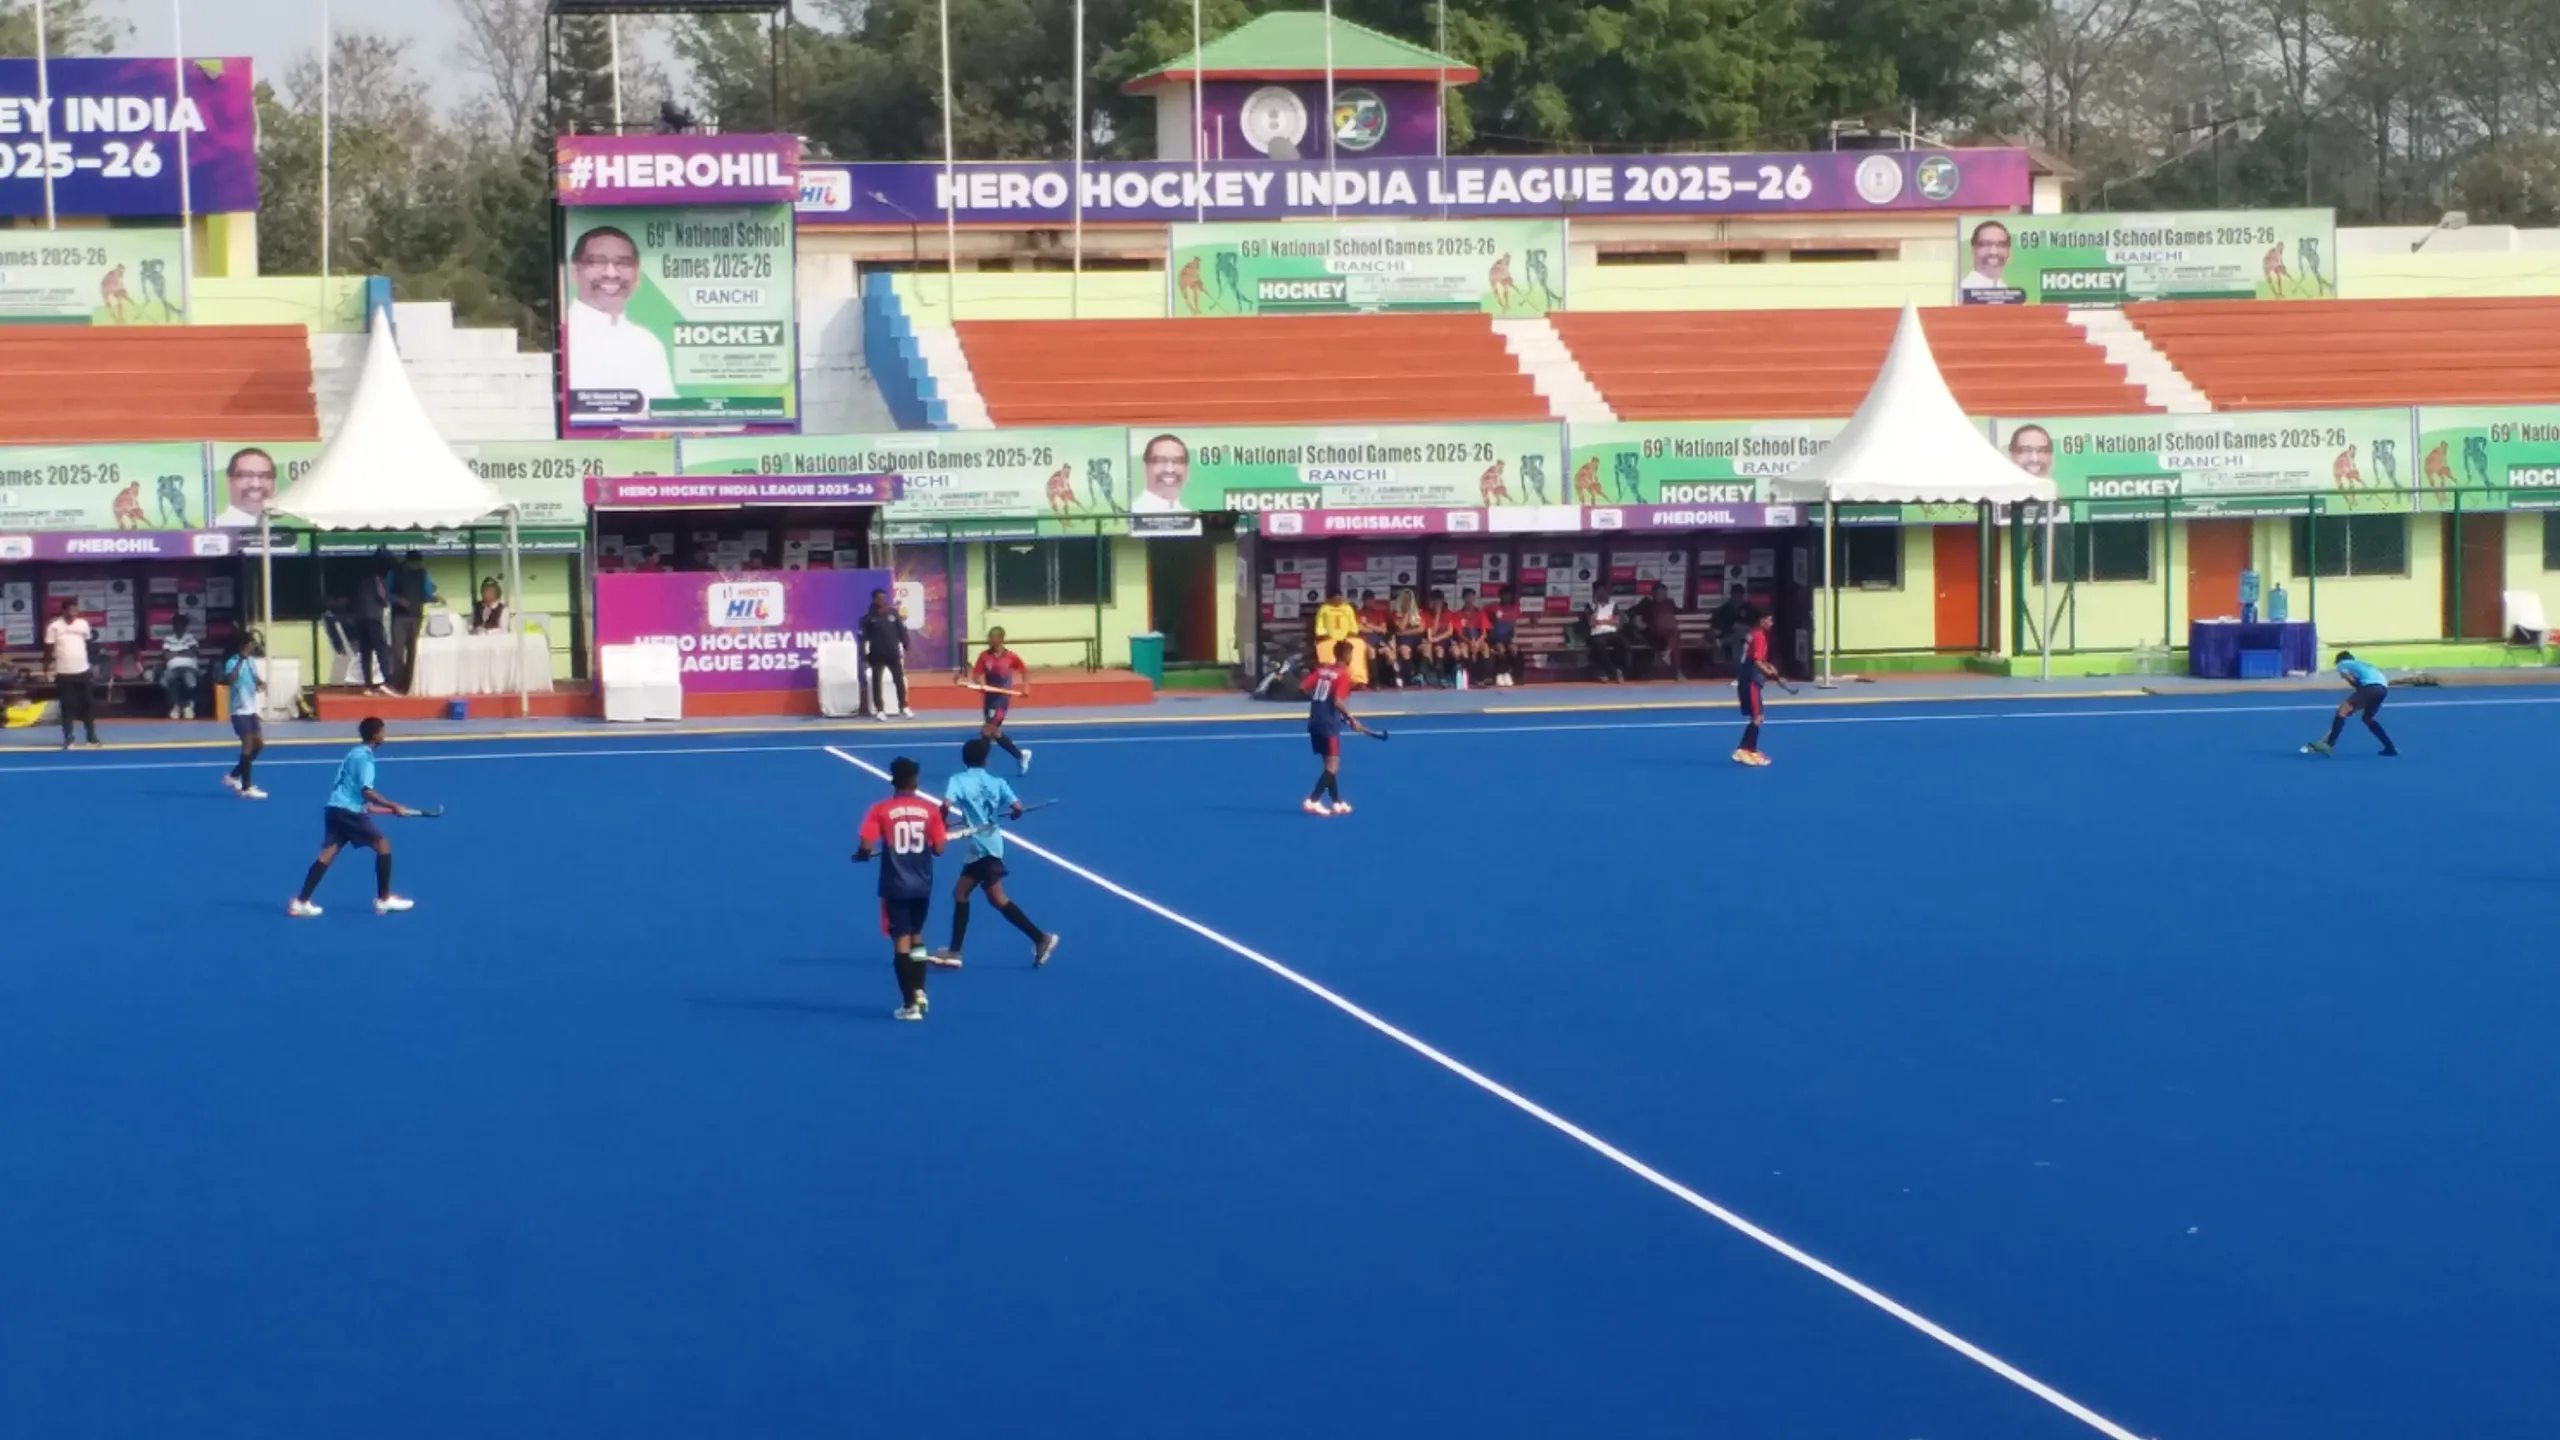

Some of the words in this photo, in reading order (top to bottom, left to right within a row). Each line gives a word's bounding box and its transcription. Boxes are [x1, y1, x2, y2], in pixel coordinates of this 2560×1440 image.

[65, 97, 206, 132] INDIA
[569, 153, 793, 188] #HEROHIL
[936, 172, 1067, 209] HERO
[1080, 170, 1274, 208] HOCKEY
[1287, 170, 1420, 206] INDIA
[1429, 167, 1614, 204] LEAGUE
[1624, 163, 1811, 200] 2025-26
[675, 221, 733, 247] National
[737, 220, 785, 246] School
[2049, 229, 2109, 248] National
[2113, 227, 2162, 247] School
[2165, 227, 2213, 246] Games
[2217, 227, 2275, 245] 2025-26
[41, 247, 107, 266] 2025-26
[1271, 240, 1331, 257] National
[1334, 237, 1382, 256] School
[1385, 237, 1433, 256] Games
[1437, 237, 1495, 256] 2025-26
[2115, 250, 2183, 262] RANCHI
[663, 253, 710, 279] Games
[713, 252, 771, 278] 2025-26
[1334, 260, 1405, 273] RANCHI
[1259, 281, 1345, 300] HOCKEY
[2042, 272, 2124, 290] HOCKEY
[696, 289, 758, 304] RANCHI
[674, 326, 780, 345] HOCKEY
[1675, 438, 1739, 457] National
[1742, 437, 1795, 456] School
[2096, 433, 2162, 453] National
[2166, 431, 2220, 451] School
[2224, 430, 2277, 450] Games
[2281, 428, 2345, 448] 2025-26
[795, 452, 862, 473] National
[867, 449, 923, 472] School
[927, 449, 982, 470] Games
[985, 447, 1053, 468] 2025-26
[1233, 444, 1301, 465] National
[1306, 443, 1363, 464] School
[1367, 443, 1421, 463] Games
[1426, 442, 1493, 462] 2025-26
[2168, 455, 2244, 468] RANCHI
[47, 463, 120, 484] 2025-26
[468, 460, 527, 479] Games
[531, 458, 604, 479] 2025-26
[1308, 468, 1387, 481] RANCHI
[1743, 461, 1797, 474] RANC
[619, 486, 657, 497] HERO
[661, 485, 715, 497] HOCKEY
[719, 484, 758, 496] INDIA
[761, 484, 813, 496] LEAGUE
[818, 484, 873, 495] 2025-26
[903, 475, 949, 488] NCHI
[2088, 478, 2179, 499] HOCKEY
[1225, 492, 1321, 511] HOCKEY
[1661, 484, 1754, 503] HOCKEY
[1325, 514, 1425, 530] #BIGISBACK
[1653, 511, 1735, 525] #HEROHIL
[67, 538, 160, 553] #HEROHIL
[701, 632, 791, 651] HOCKEY
[748, 653, 819, 671] 2025-2
[894, 821, 925, 853] 05
